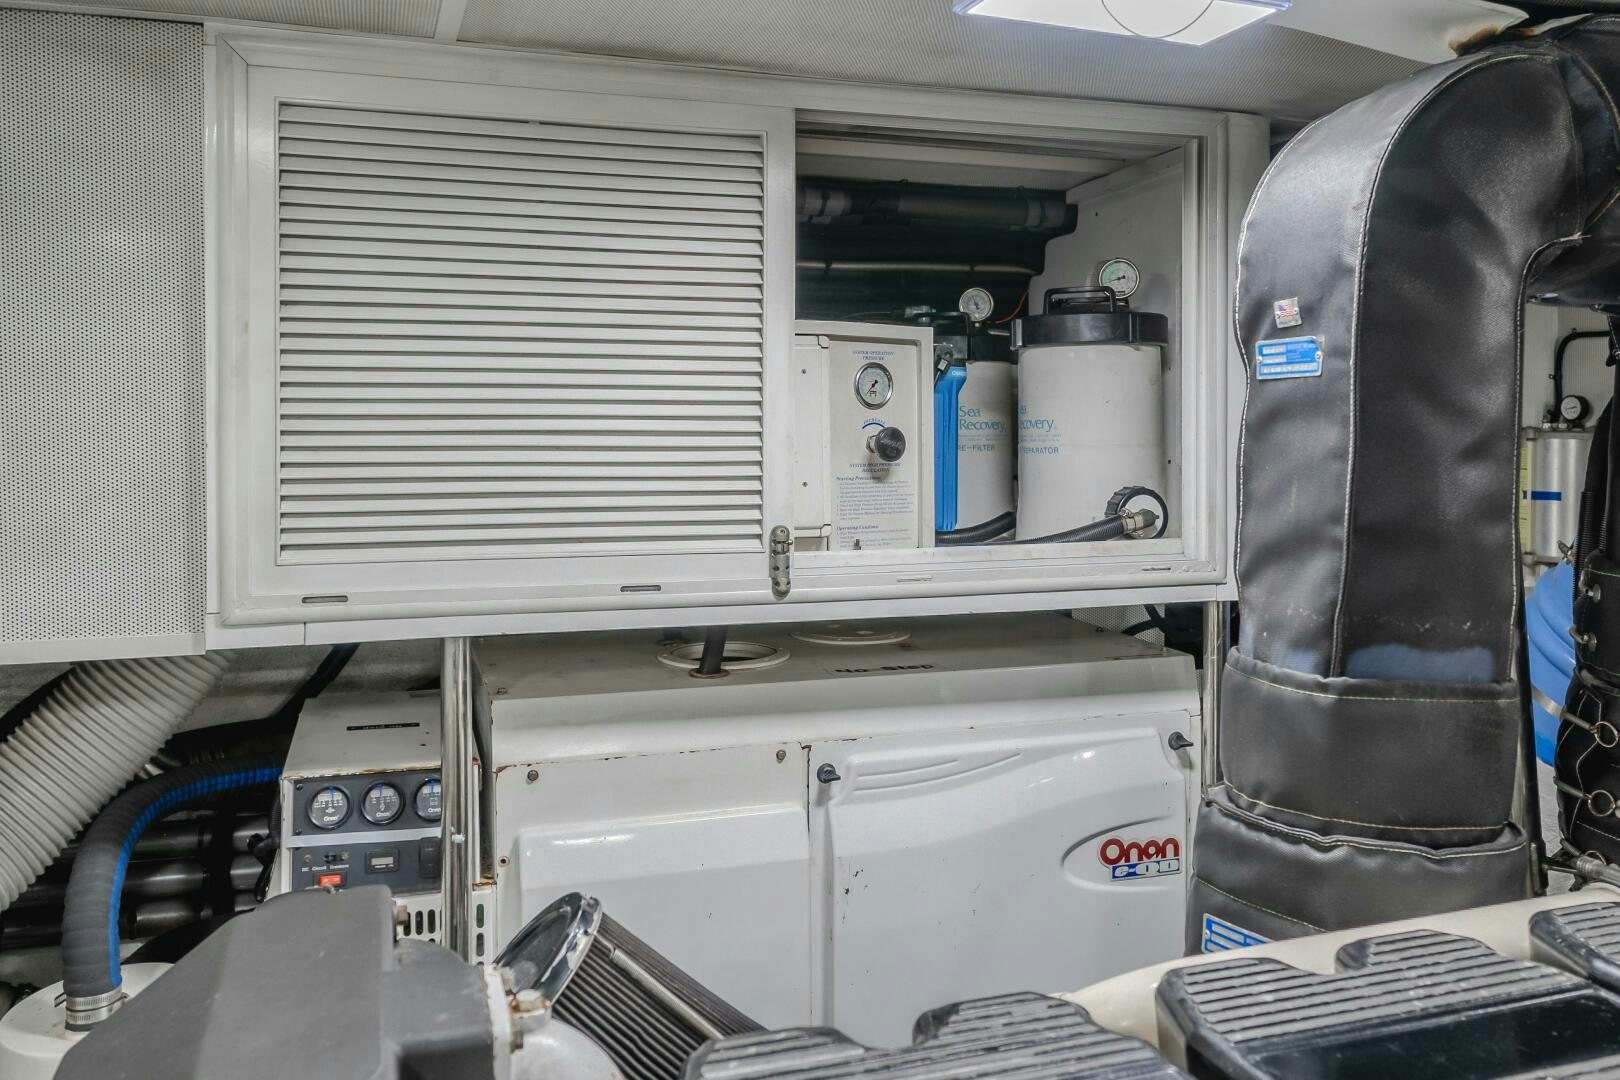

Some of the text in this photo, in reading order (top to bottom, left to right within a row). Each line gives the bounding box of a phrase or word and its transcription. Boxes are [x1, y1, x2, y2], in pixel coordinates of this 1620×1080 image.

[959, 405, 981, 417] Sea
[959, 419, 1005, 432] Recovery
[1019, 419, 1054, 432] ecovery
[958, 444, 994, 452] RE-FILTER
[1100, 838, 1180, 866] Onan
